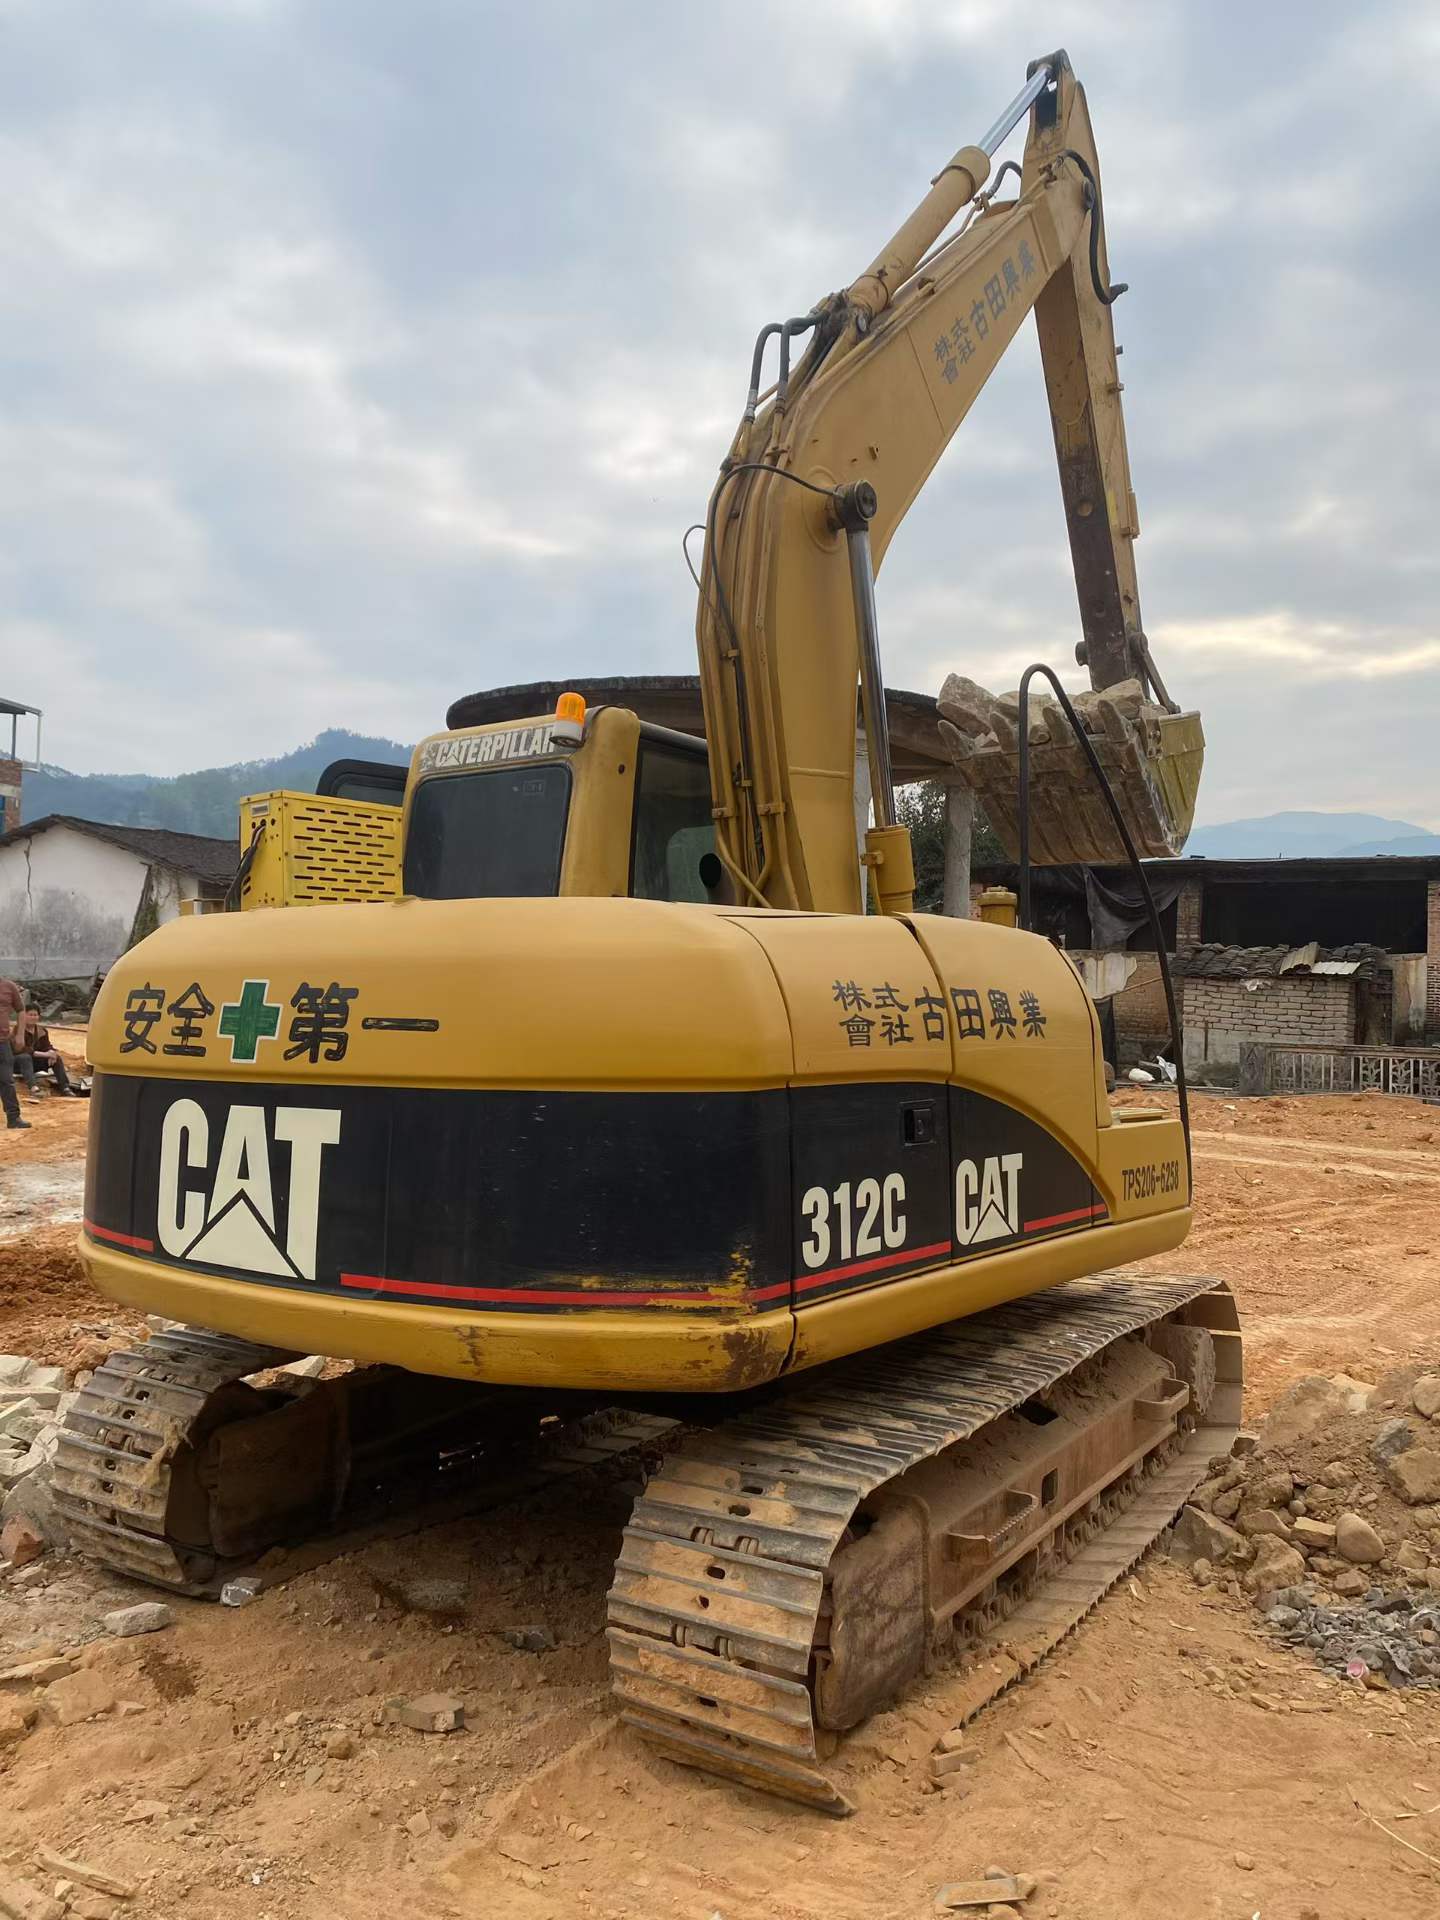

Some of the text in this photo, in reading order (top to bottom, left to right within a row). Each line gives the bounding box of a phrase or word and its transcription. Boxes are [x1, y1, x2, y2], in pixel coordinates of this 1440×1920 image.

[157, 1098, 342, 1281] CAT
[801, 1172, 907, 1268] 312C
[955, 1152, 1023, 1246] CAT
[1121, 1160, 1179, 1201] TPS206-6258
